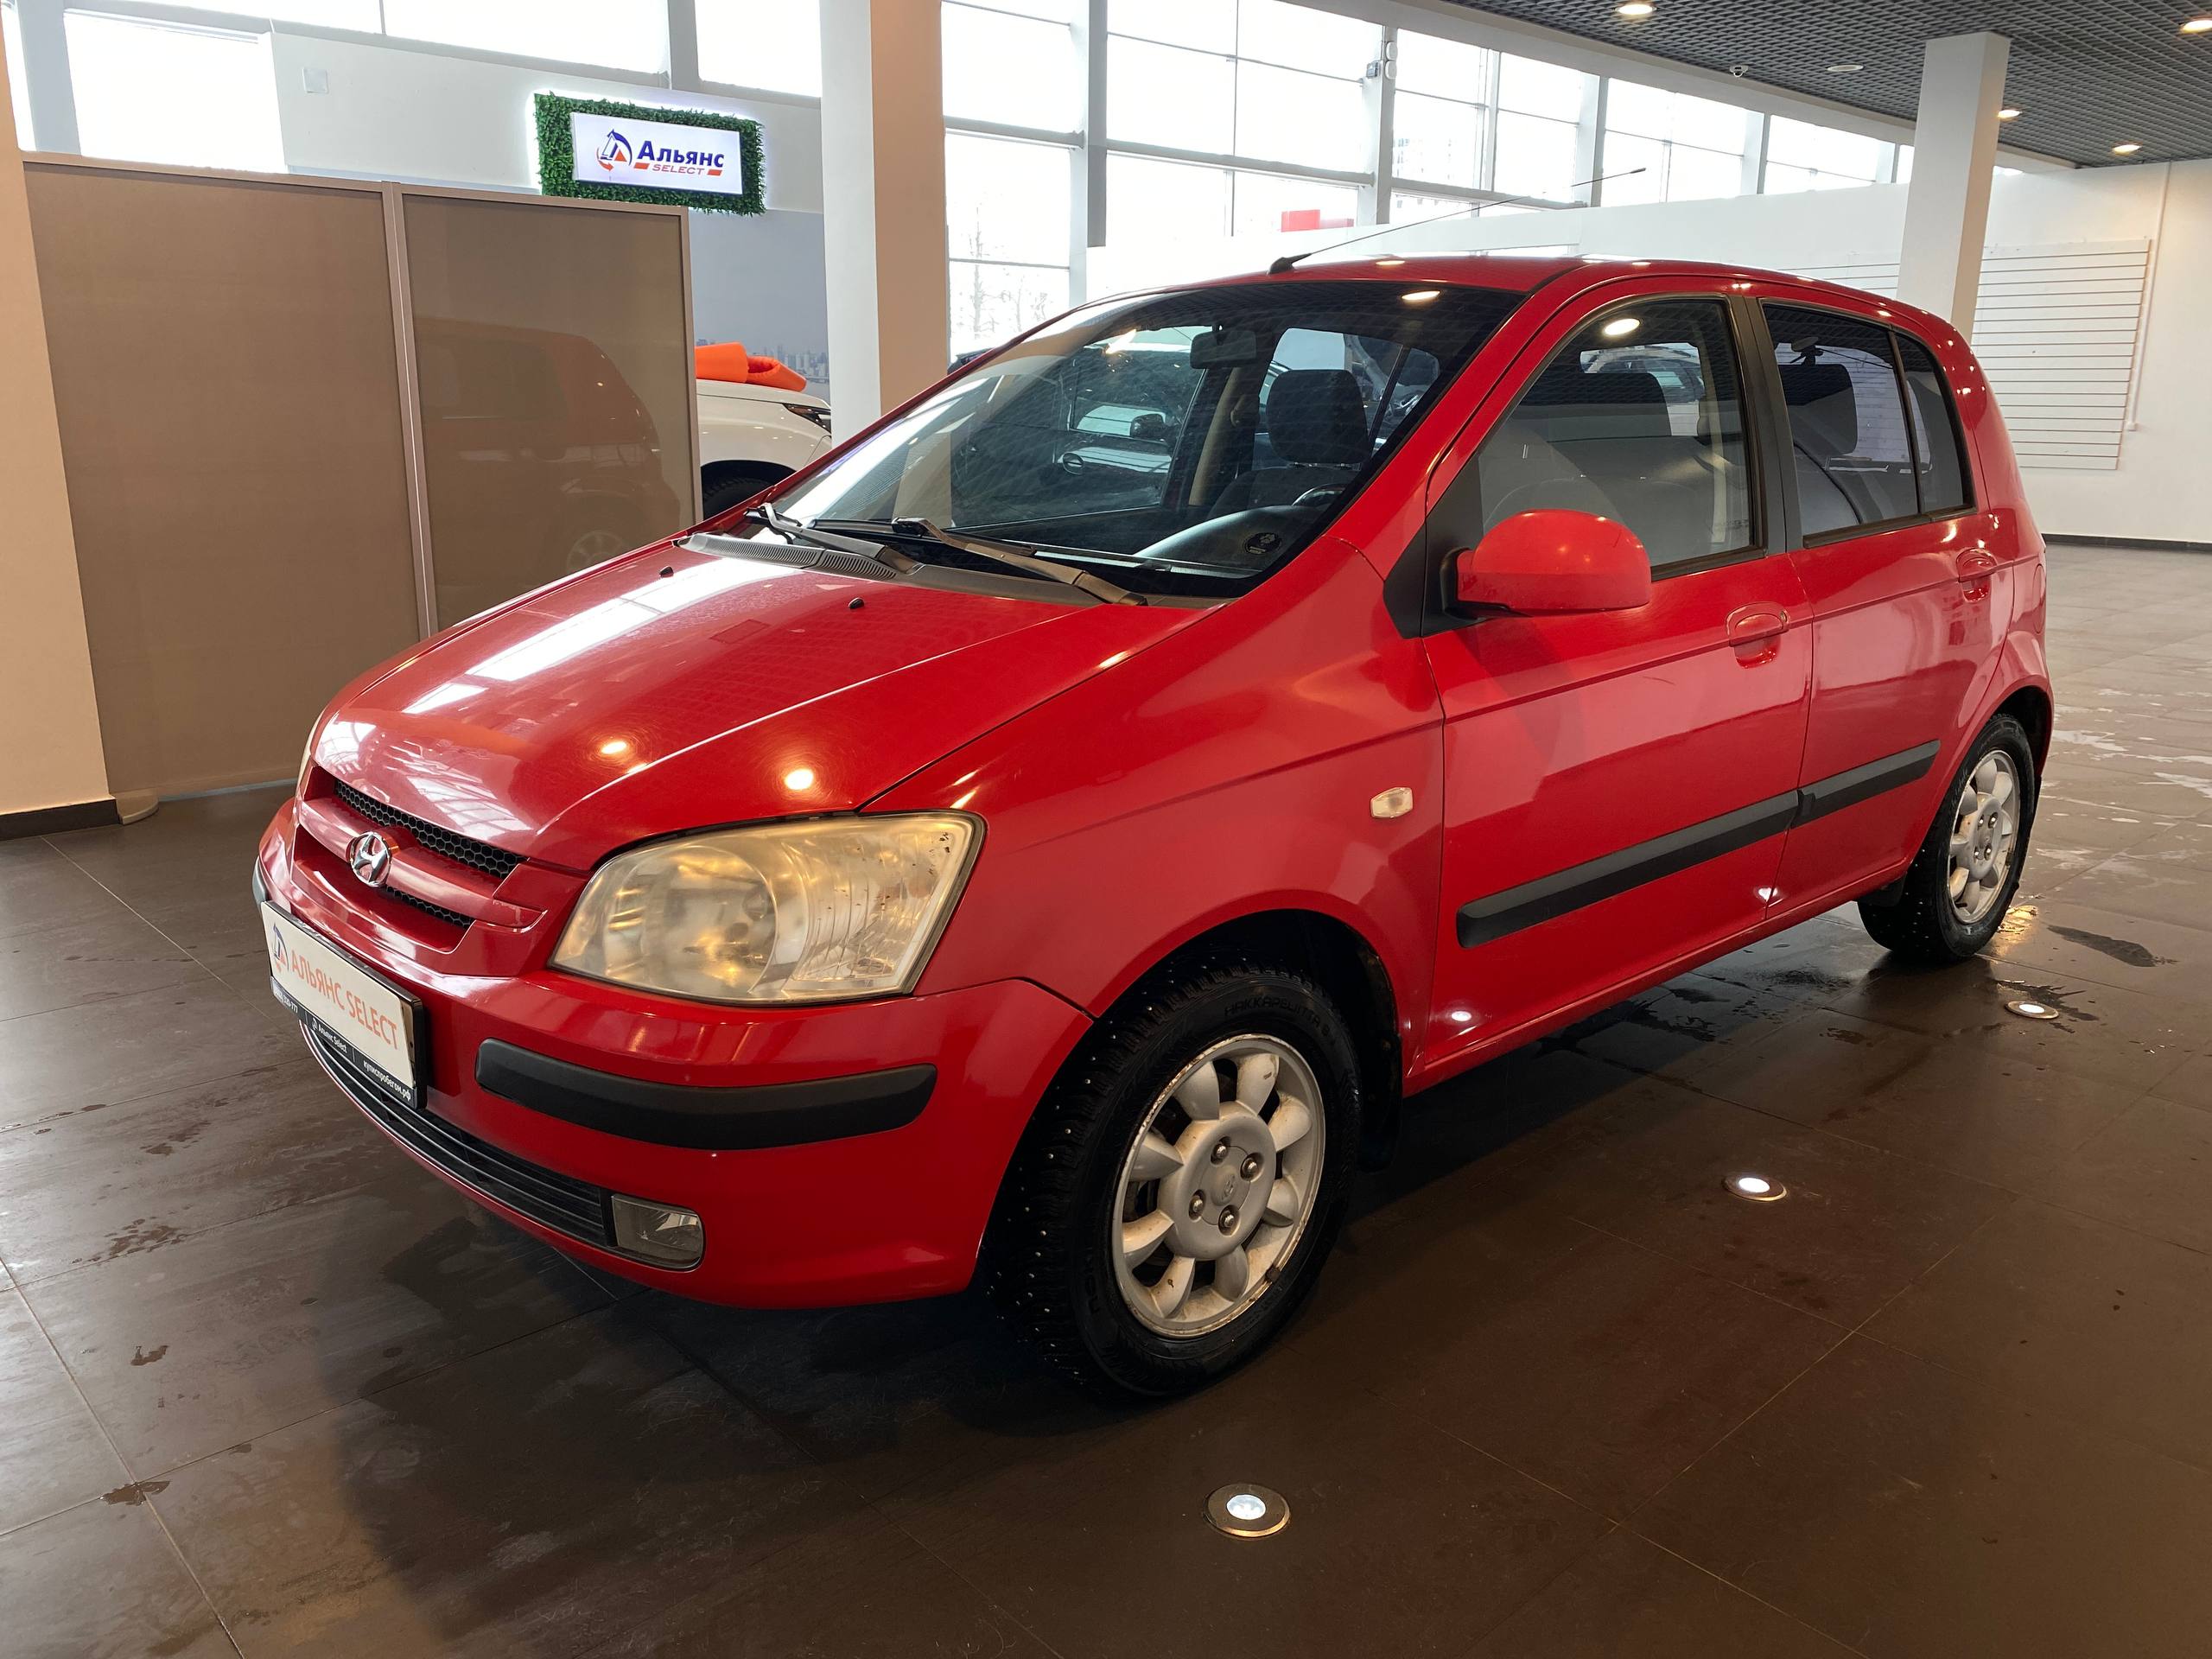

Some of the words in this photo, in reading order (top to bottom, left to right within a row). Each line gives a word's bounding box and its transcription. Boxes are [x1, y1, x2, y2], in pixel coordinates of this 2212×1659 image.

[637, 140, 725, 168] Альянс
[652, 163, 705, 175] SELECT
[291, 950, 345, 1010] АЛЬЯНС
[346, 989, 397, 1050] SELECT
